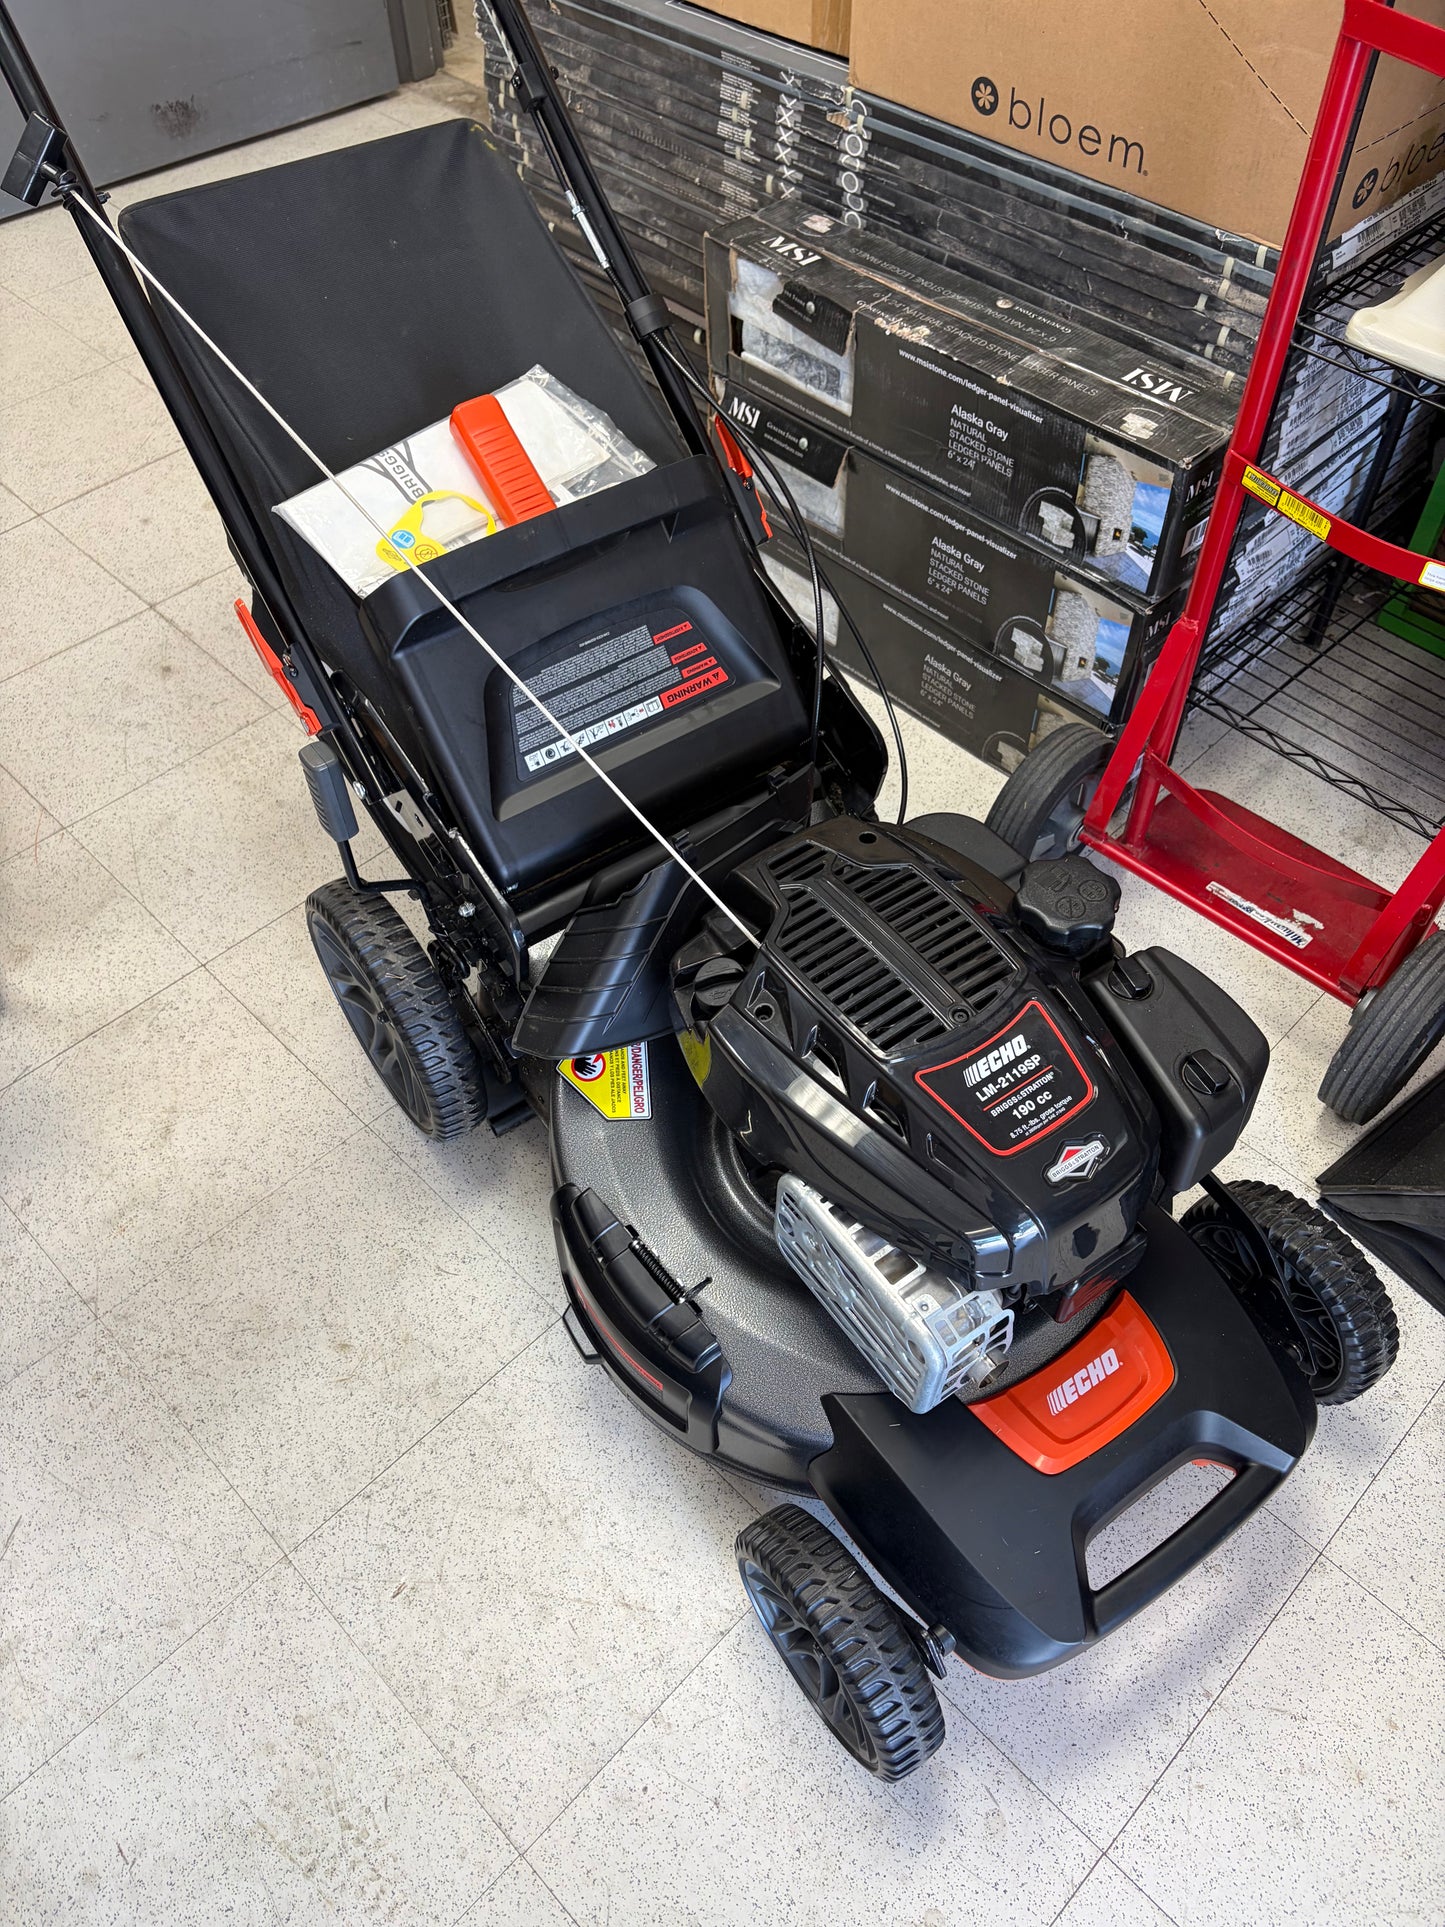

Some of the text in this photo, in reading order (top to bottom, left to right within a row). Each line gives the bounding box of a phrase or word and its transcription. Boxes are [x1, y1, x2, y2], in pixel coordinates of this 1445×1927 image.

[1008, 87, 1145, 173] bloem
[761, 235, 822, 266] MSI
[903, 306, 943, 327] NATURAL
[943, 325, 987, 349] STACKED
[985, 340, 1021, 362] STONE
[1058, 372, 1098, 396] PANELS
[899, 349, 1044, 424] www.msistone.com/ledger-panel-visualizer
[1121, 367, 1195, 403] MSI
[727, 397, 761, 429] MSI
[950, 418, 987, 443] NATURAL
[951, 403, 1009, 442] Alaska Gray
[948, 440, 1013, 478] LEDGER PANELS
[949, 429, 1015, 468] STACKED STONE
[930, 548, 965, 573] NATURAL
[931, 536, 985, 574] Alaska Gray
[928, 567, 988, 606] LEDGER PANELS
[929, 558, 991, 597] STACKED STONE
[687, 661, 709, 674] WARNING
[923, 664, 954, 690] NATURAL
[924, 653, 972, 692] Alaska Gray
[667, 678, 713, 703] WARNING
[921, 681, 947, 703] LEDGER
[947, 698, 974, 720] PANELS
[922, 672, 953, 697] STACKED
[953, 691, 977, 713] STONE
[976, 1034, 1029, 1080] ECHO
[975, 1054, 1042, 1103] LM-2119SP
[1009, 1095, 1073, 1139] 8.75 ft.-lbs. gross torque
[1012, 1091, 1053, 1120] 190 cc
[1052, 1144, 1100, 1178] BRIGGS&STRATTON
[1061, 1347, 1120, 1406] ECHO
